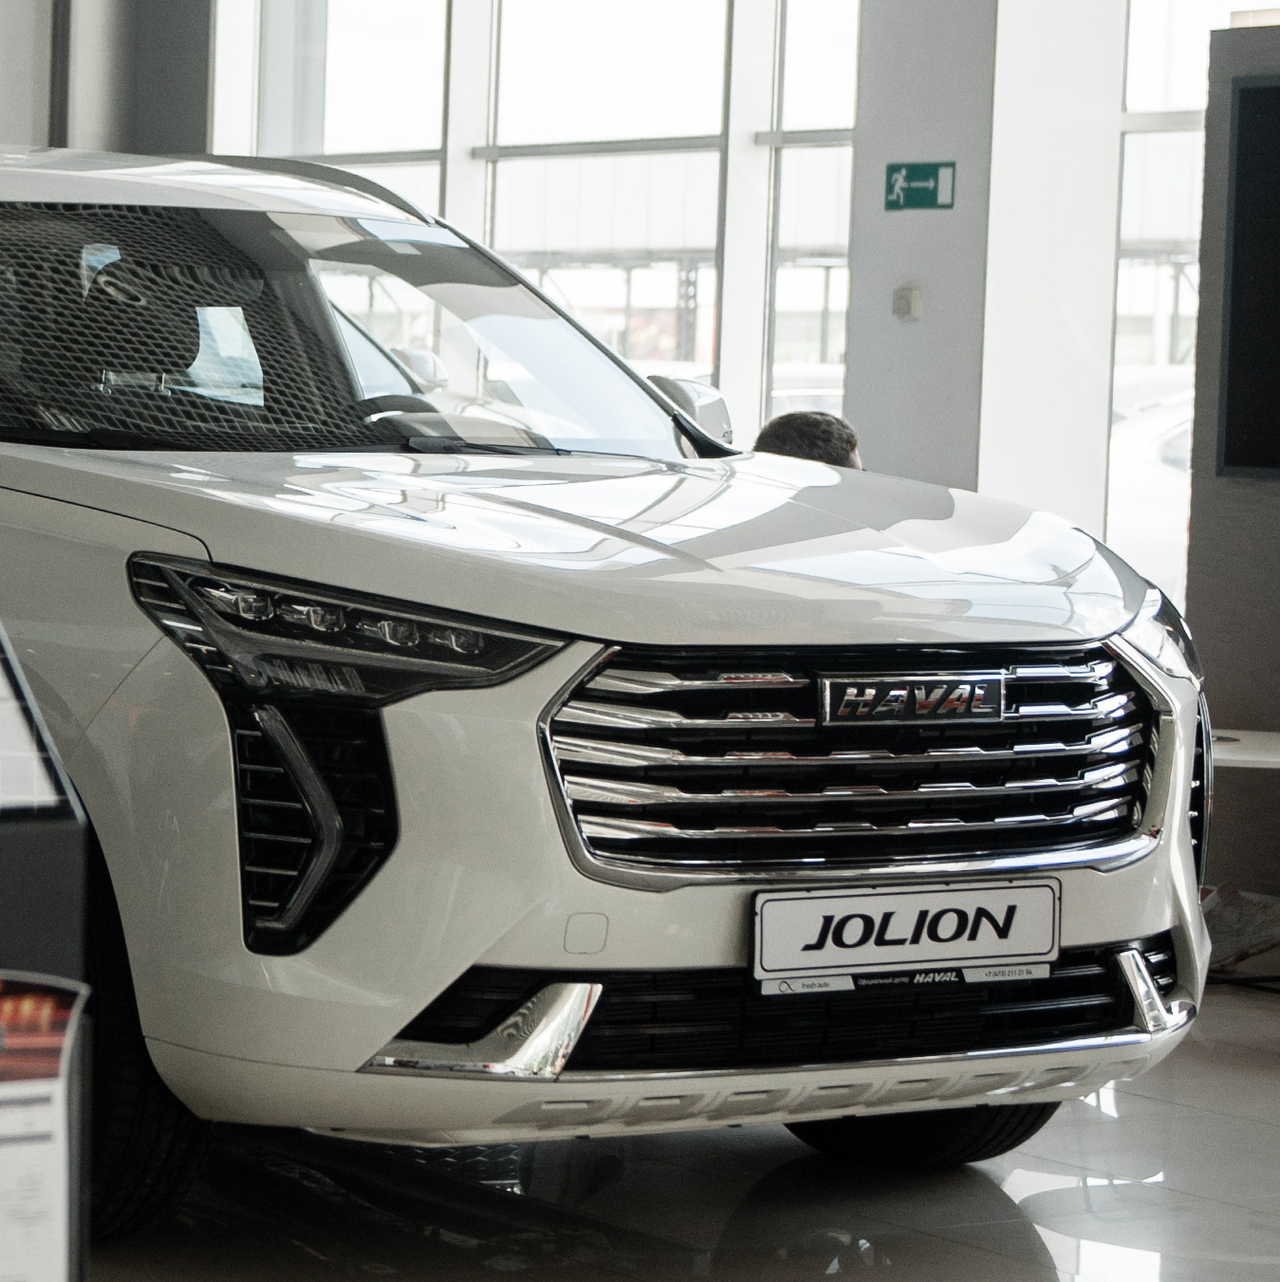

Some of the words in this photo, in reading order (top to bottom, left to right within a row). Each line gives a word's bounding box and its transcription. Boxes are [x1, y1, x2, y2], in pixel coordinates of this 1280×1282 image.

[837, 684, 997, 716] HAVAL
[800, 904, 1018, 952] JOLION
[913, 971, 960, 984] HAVAL
